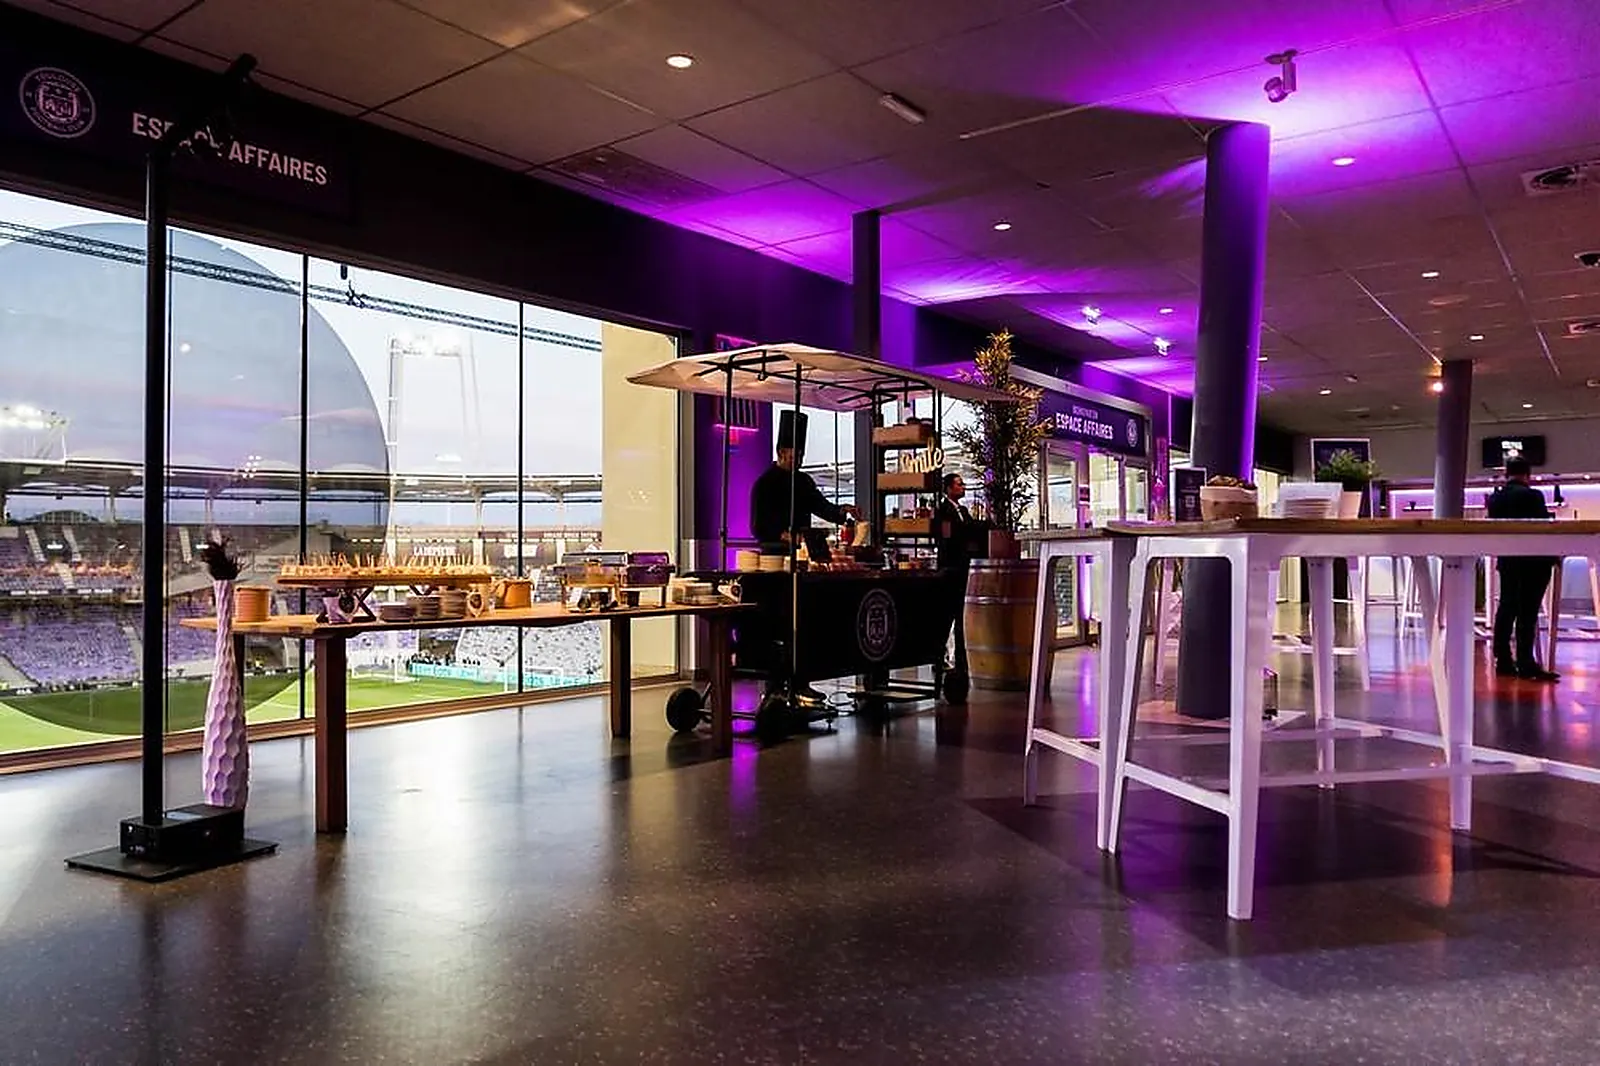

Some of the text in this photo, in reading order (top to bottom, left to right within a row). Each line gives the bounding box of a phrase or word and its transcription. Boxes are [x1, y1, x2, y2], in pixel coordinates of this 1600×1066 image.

[228, 140, 328, 186] AFFAIRES
[1056, 413, 1082, 434] ESPACE
[1083, 420, 1114, 440] AFFAIRES
